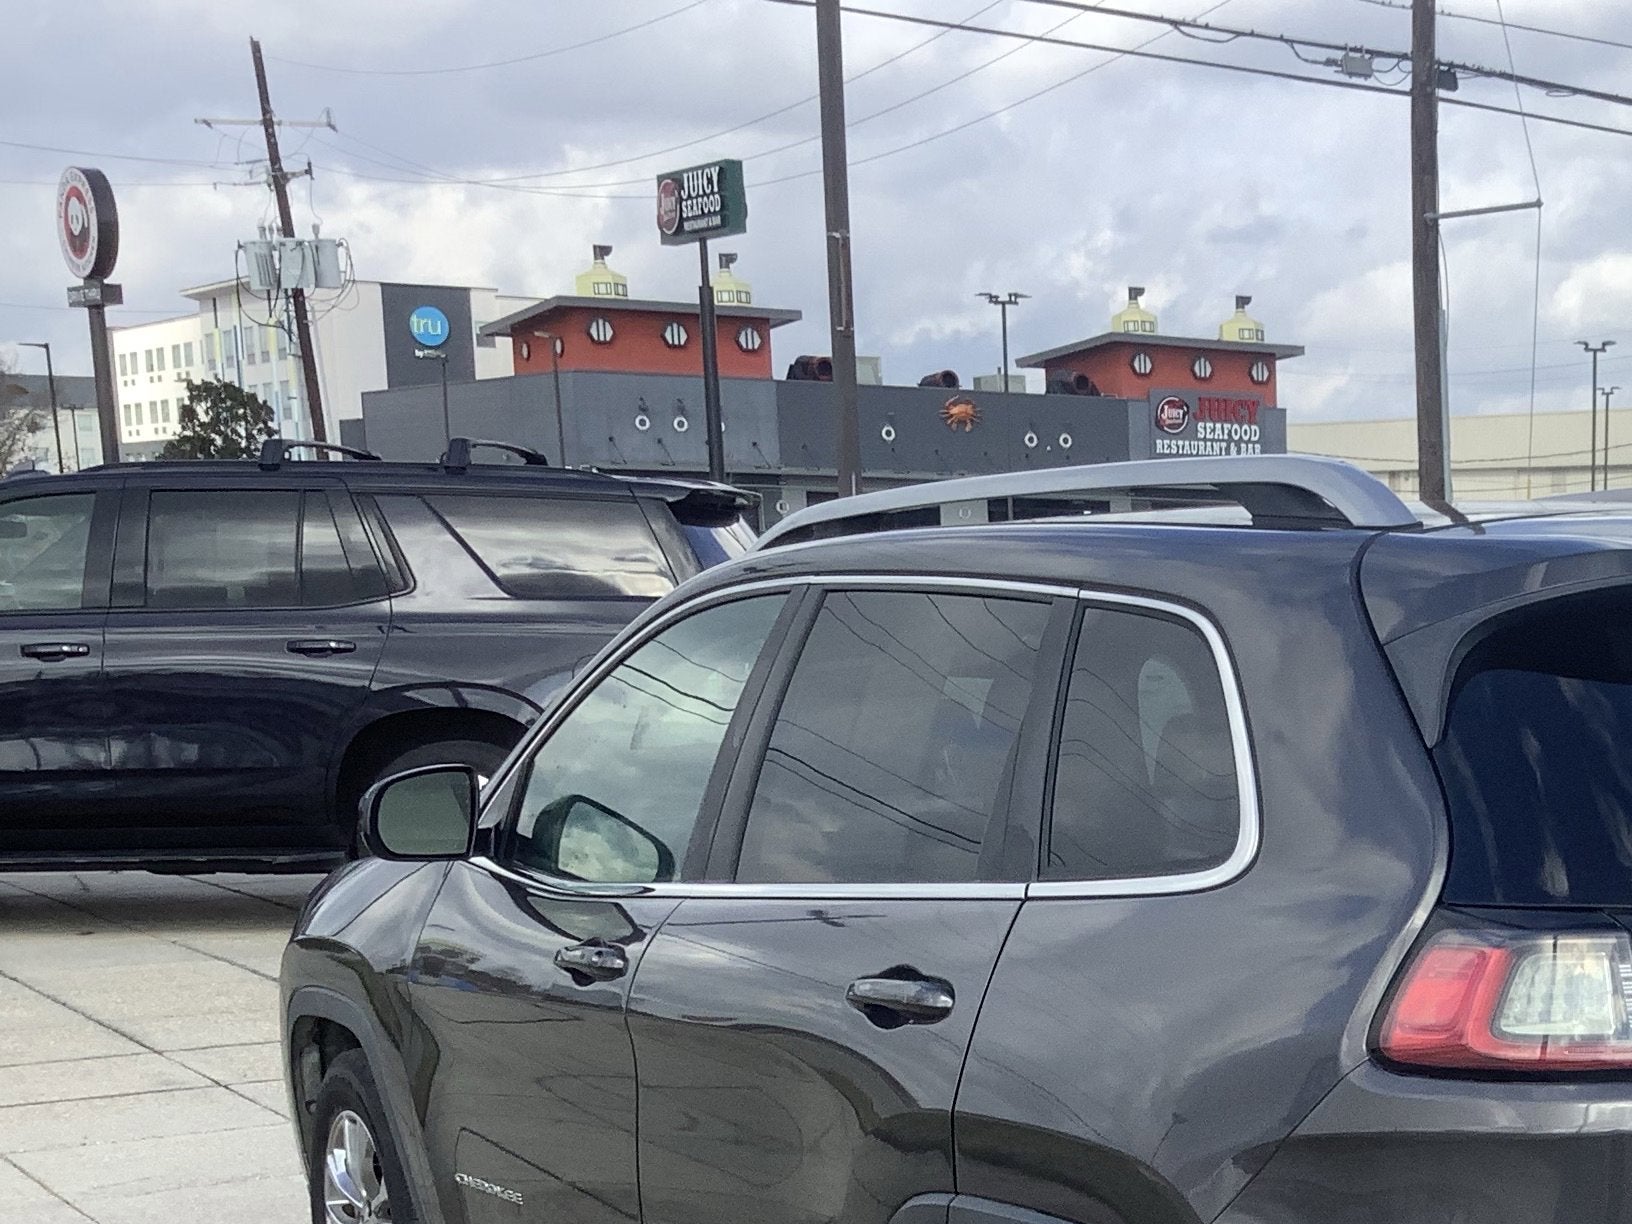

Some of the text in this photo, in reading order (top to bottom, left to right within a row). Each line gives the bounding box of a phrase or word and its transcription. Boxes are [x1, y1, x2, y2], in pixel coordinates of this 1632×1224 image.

[681, 166, 720, 200] JUICY
[681, 194, 721, 218] SEAFOOD
[410, 314, 442, 335] tru
[1193, 397, 1260, 424] JUICY
[1197, 421, 1260, 441] SEAFOOD
[1156, 439, 1261, 456] RESTAURANT & BAR
